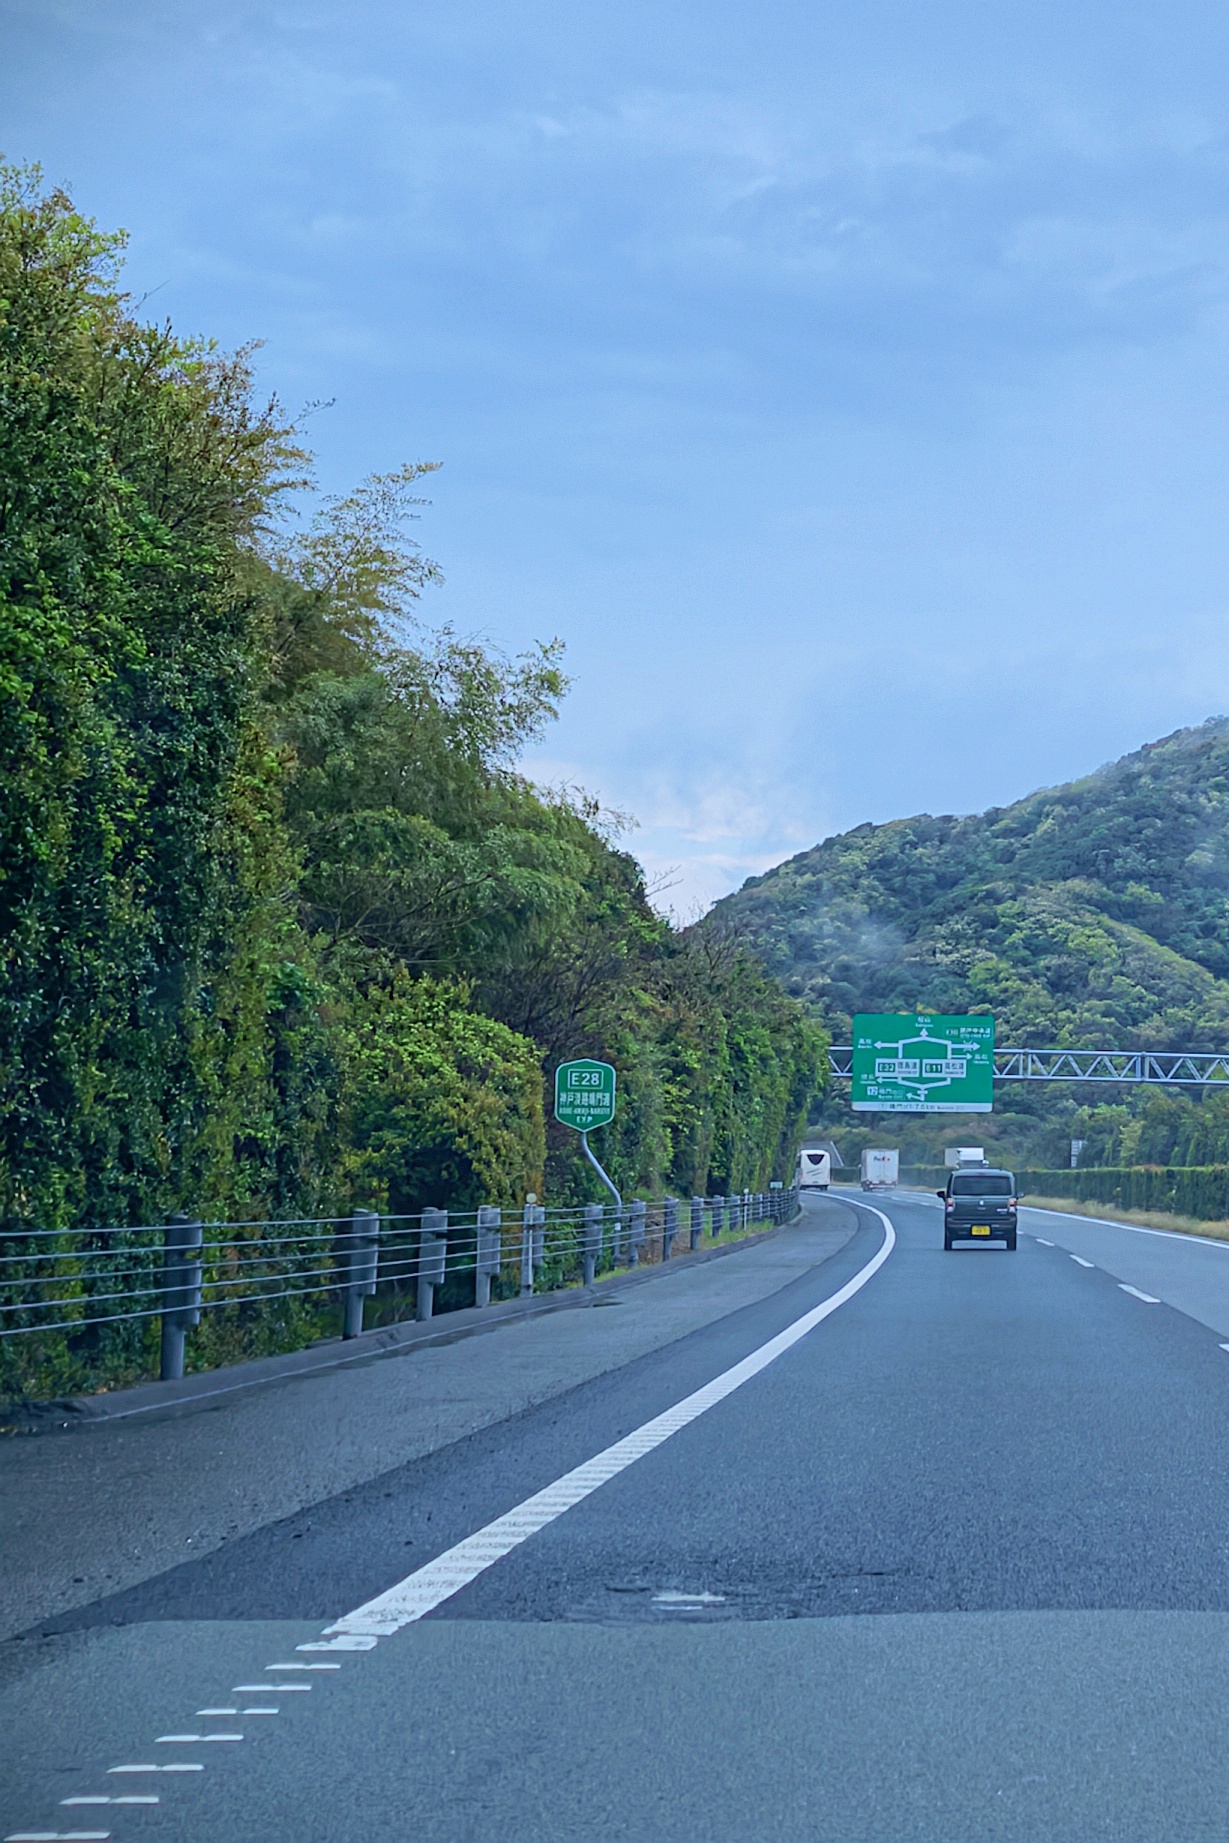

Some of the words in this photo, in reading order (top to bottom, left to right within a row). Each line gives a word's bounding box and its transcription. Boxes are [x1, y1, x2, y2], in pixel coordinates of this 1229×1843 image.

[879, 1063, 894, 1071] E32
[925, 1064, 941, 1072] E11
[571, 1072, 599, 1085] E28
